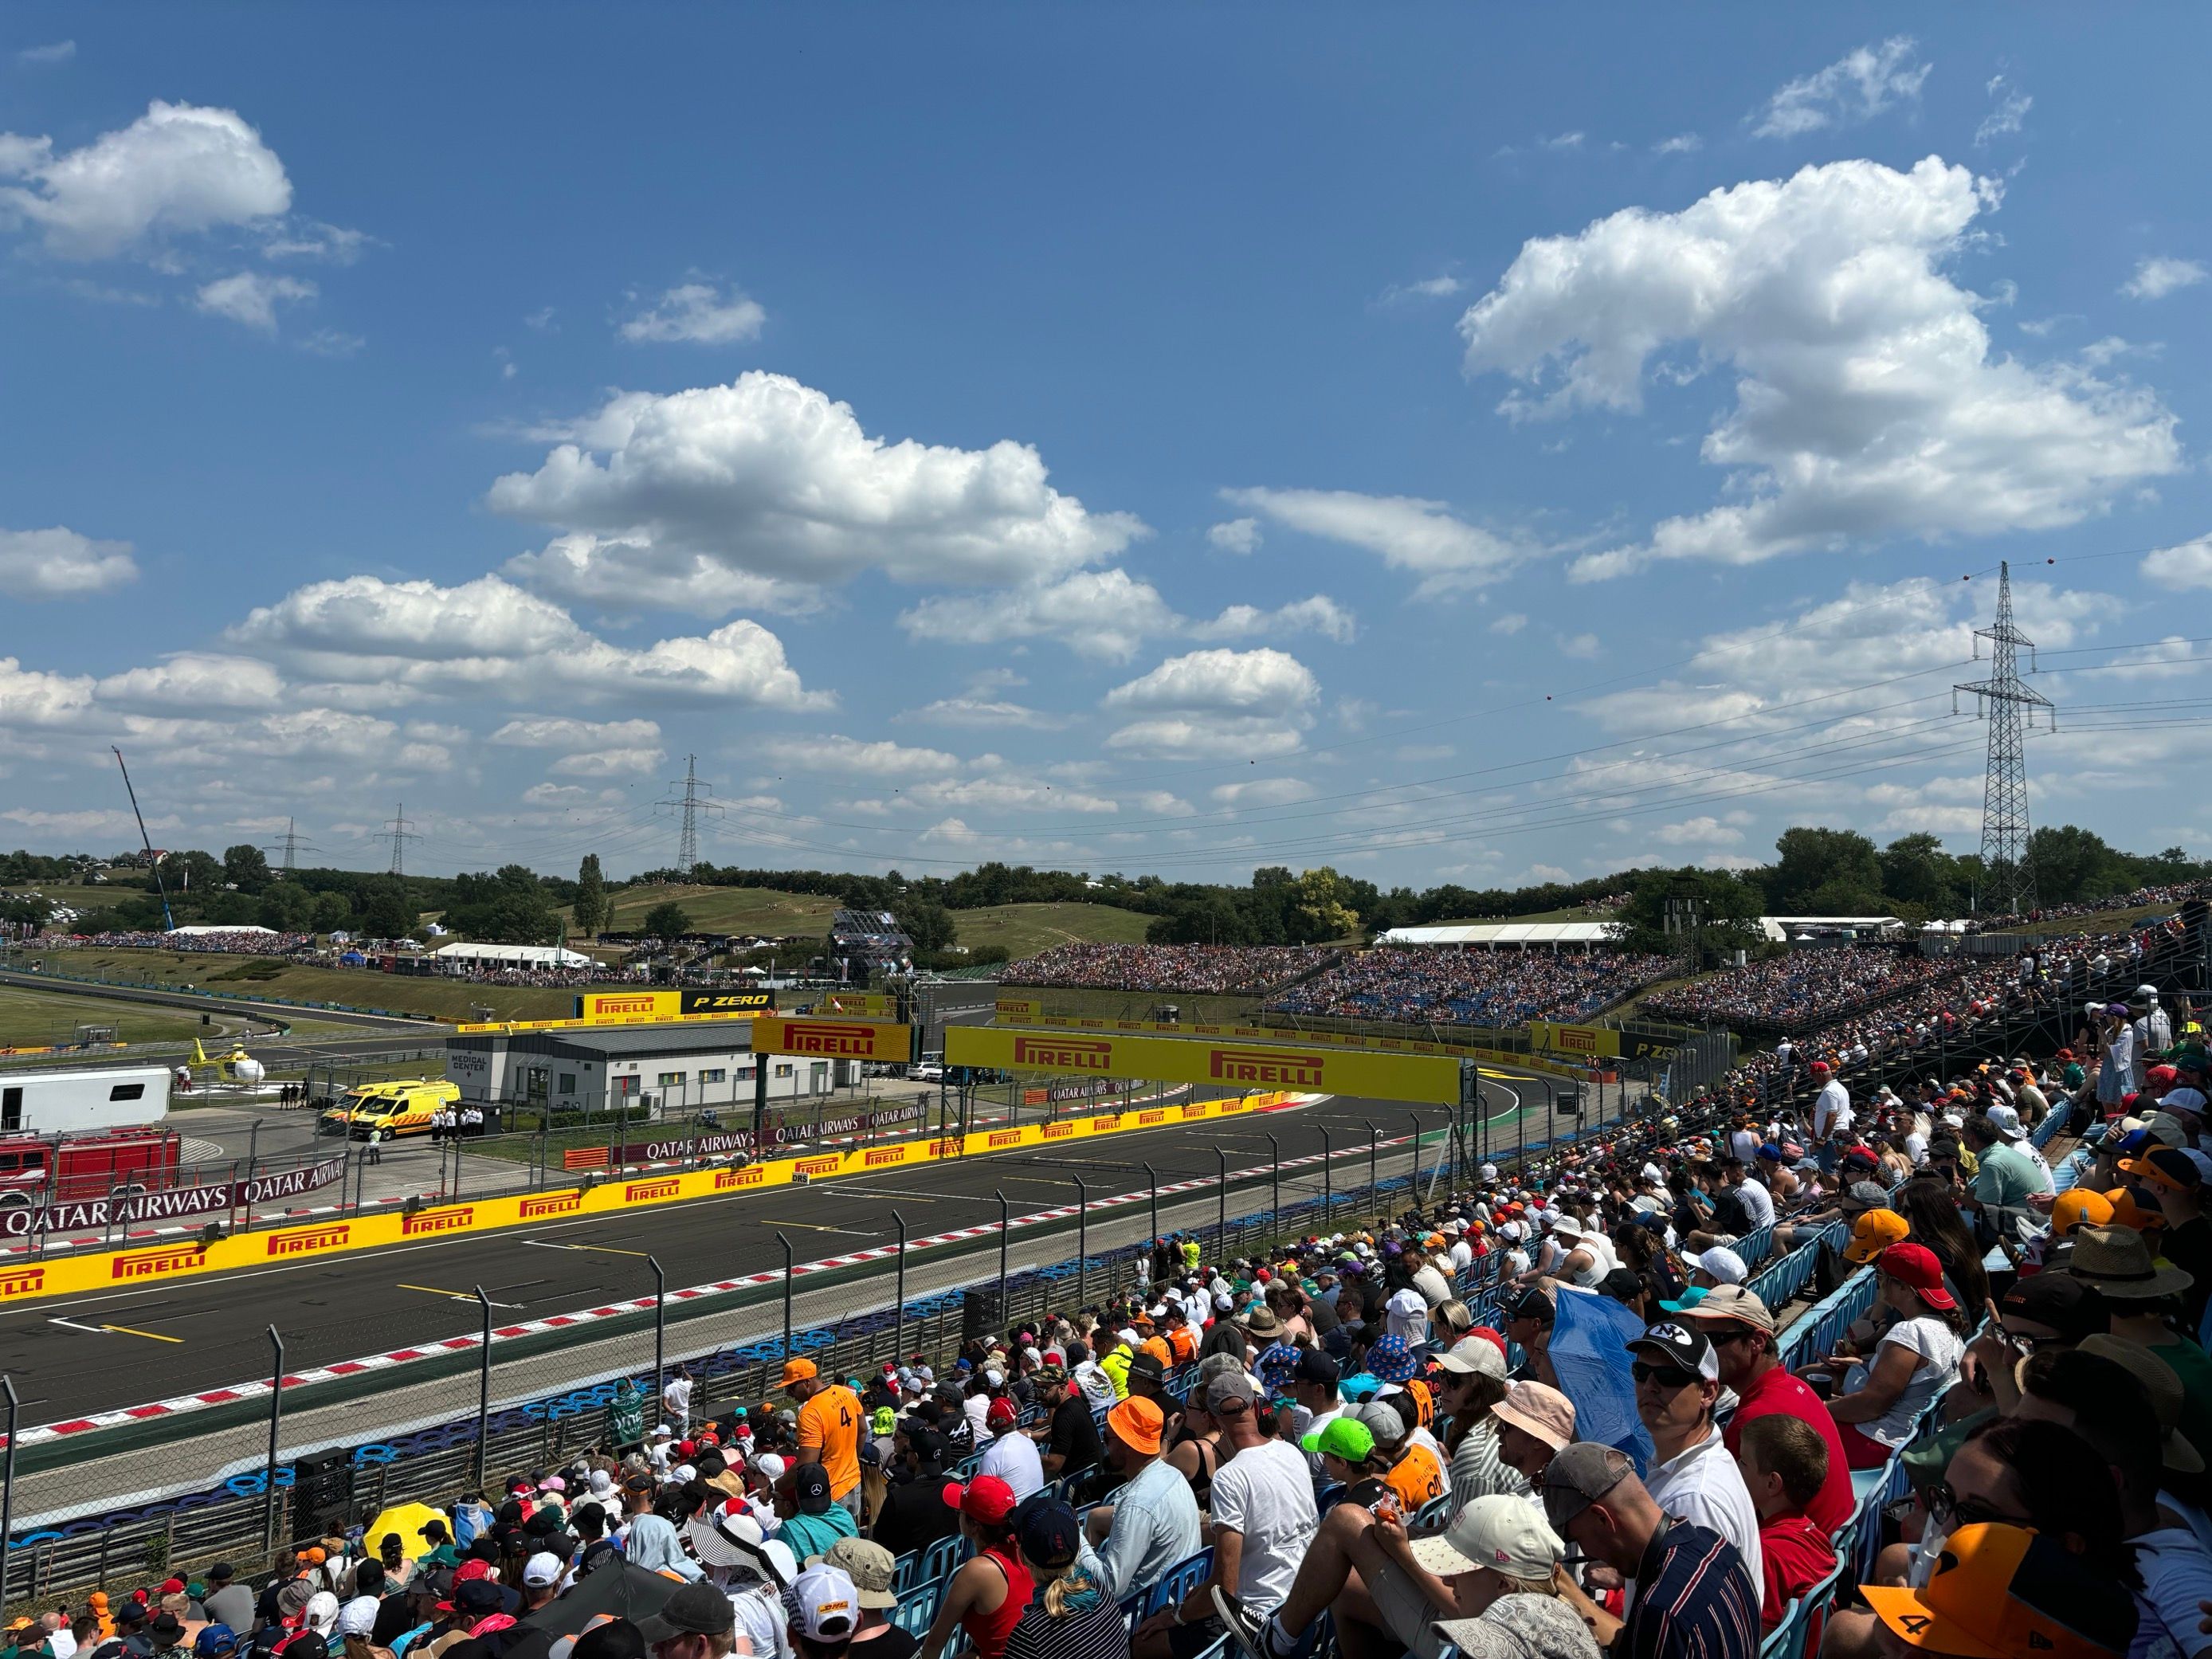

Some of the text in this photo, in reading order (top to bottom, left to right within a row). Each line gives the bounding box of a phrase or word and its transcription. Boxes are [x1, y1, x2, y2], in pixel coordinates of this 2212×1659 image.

[596, 997, 654, 1014] PIRELLI
[693, 994, 769, 1007] P ZERO
[996, 1001, 1030, 1014] PIRELLI
[784, 1023, 875, 1055] PIRELLI
[1559, 1029, 1596, 1050] PIRELLI
[1014, 1037, 1112, 1069] PIRELLI
[1636, 1042, 1649, 1056] P
[452, 1055, 487, 1065] MEDICAL
[453, 1061, 485, 1072] CENTER
[1210, 1050, 1324, 1086] PIRELLI
[1053, 1088, 1079, 1101] QATAR
[1258, 1095, 1274, 1106] PIRELLI
[1182, 1105, 1206, 1118] PIRELLI
[1222, 1098, 1243, 1112] PIRELLI
[872, 1110, 899, 1127] QATAR
[1093, 1116, 1121, 1131] PIRELLI
[1139, 1110, 1164, 1125] PIRELLI
[776, 1117, 859, 1143] QATAR AIRWAYS
[989, 1130, 1022, 1147] PIRELLI
[1044, 1123, 1073, 1139] PIRELLI
[647, 1131, 755, 1160] QATAR AIRWAYS
[865, 1147, 904, 1166] PIRELLI
[716, 1167, 763, 1189] PIRELLI
[792, 1173, 808, 1183] DRS
[245, 1173, 304, 1203] QATAR
[626, 1179, 680, 1202] PIRELLI
[6, 1185, 226, 1235] QATAR AIRWAYS
[520, 1193, 581, 1218] PIRELLI
[402, 1207, 473, 1235] PIRELLI
[268, 1225, 350, 1256] PIRELLI
[112, 1246, 208, 1280] PIRELLI
[1656, 1324, 1686, 1340] NY
[841, 1406, 853, 1427] 4
[1422, 1402, 1432, 1430] 4
[1417, 1463, 1434, 1485] PIASTRI
[1898, 1615, 1932, 1635] 4
